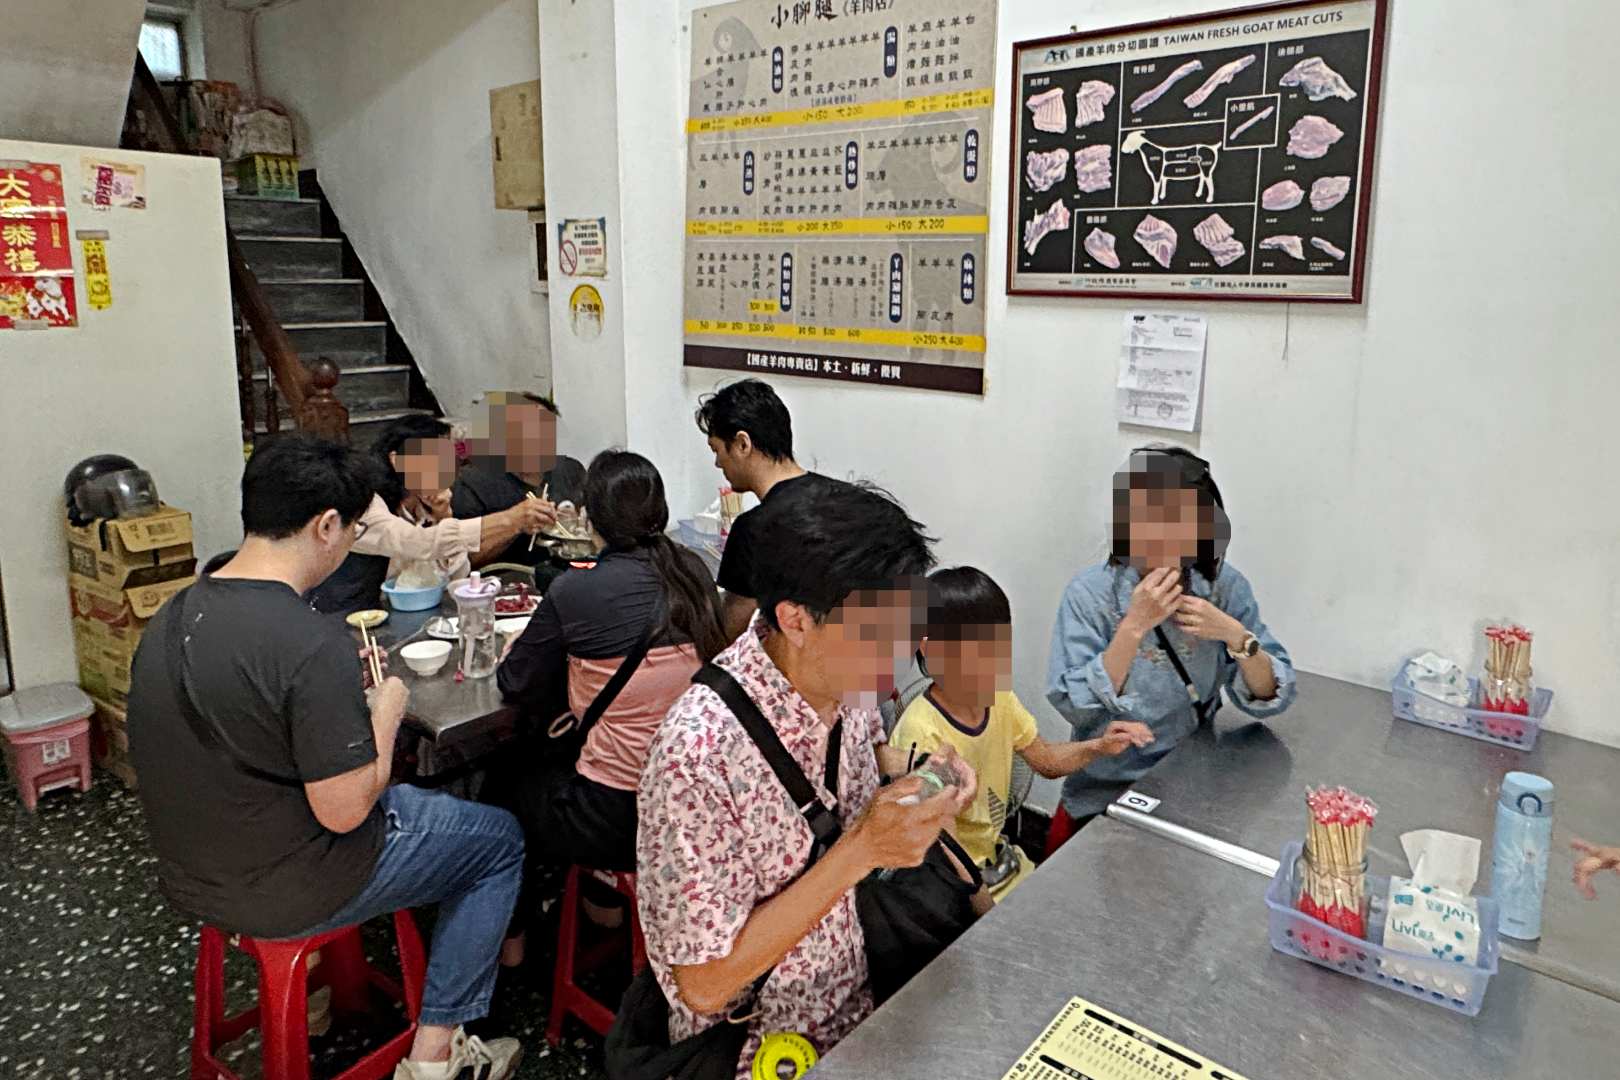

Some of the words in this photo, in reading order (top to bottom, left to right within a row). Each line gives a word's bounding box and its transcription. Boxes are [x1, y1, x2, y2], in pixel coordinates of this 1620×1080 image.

[1164, 32, 1204, 46] TAIWAN
[1207, 25, 1239, 39] FRESH
[1243, 21, 1273, 35] GOAT
[1277, 16, 1309, 30] MEAT
[1312, 10, 1344, 24] CUTS
[886, 219, 912, 231] 小150
[918, 218, 945, 230] 大200
